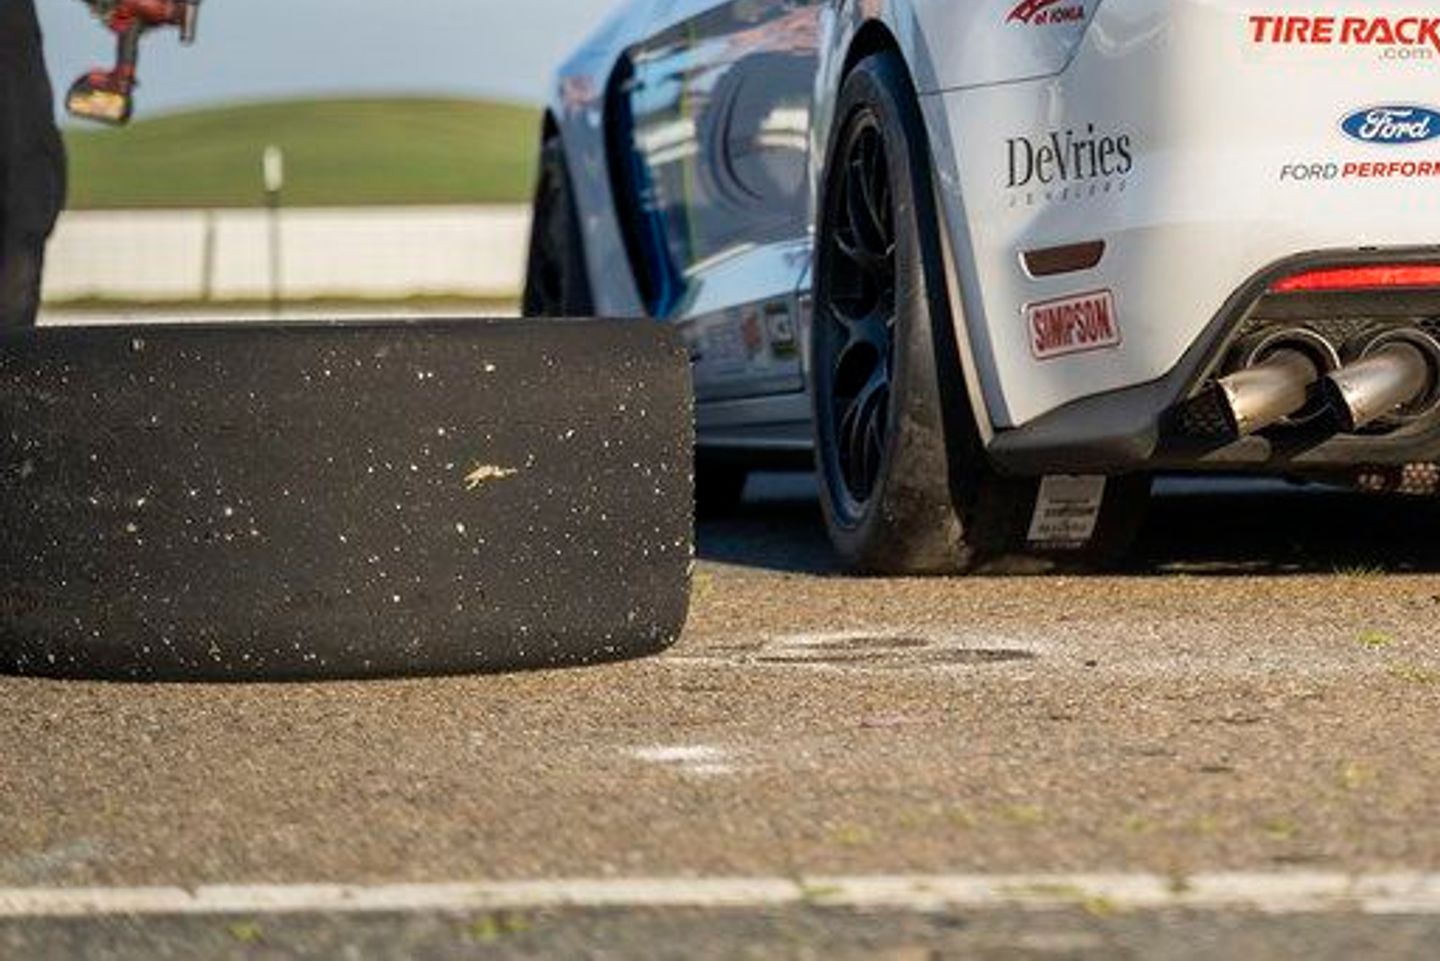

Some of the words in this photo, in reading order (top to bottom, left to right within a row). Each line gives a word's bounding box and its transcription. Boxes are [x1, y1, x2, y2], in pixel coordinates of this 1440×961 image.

[1249, 16, 1335, 43] TIRE
[1377, 47, 1433, 60] .com
[1358, 109, 1431, 140] Ford
[1004, 123, 1132, 189] DeVries
[1279, 163, 1338, 181] FORD
[1031, 296, 1113, 352] SIMPSON
